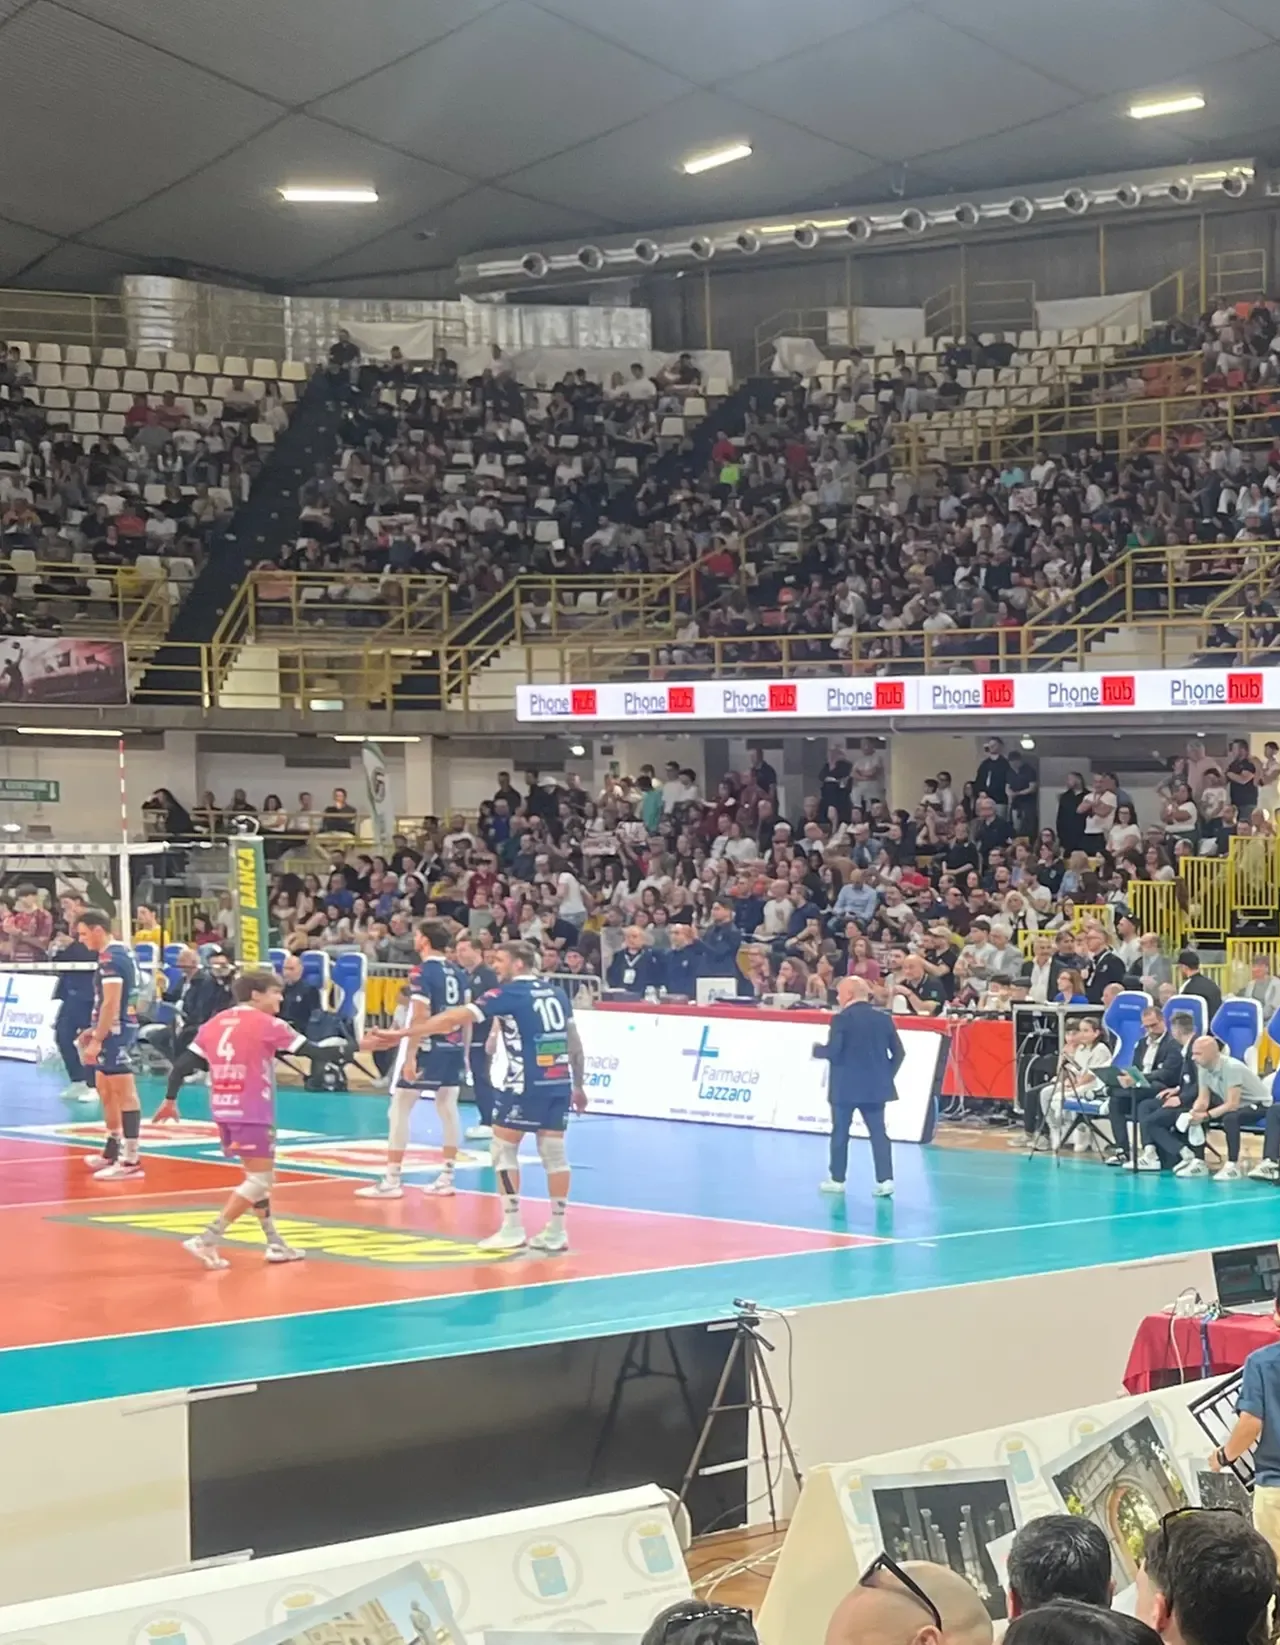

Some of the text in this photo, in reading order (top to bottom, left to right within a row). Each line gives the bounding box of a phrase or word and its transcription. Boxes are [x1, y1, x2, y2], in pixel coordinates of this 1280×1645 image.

[723, 688, 794, 709] Phone hub
[827, 685, 902, 707] Phone hub
[933, 683, 1012, 705] Phone hub
[1048, 680, 1132, 702] Phone hub
[1171, 677, 1260, 700] Phone hub
[530, 692, 595, 713] Phone hub
[624, 690, 692, 711] Phone hub
[445, 976, 459, 1004] 8
[533, 997, 565, 1031] 10
[2, 1023, 36, 1039] Lazzaro
[216, 1026, 235, 1063] 4
[702, 1065, 759, 1085] Farmacia
[699, 1083, 751, 1103] Lazzaro
